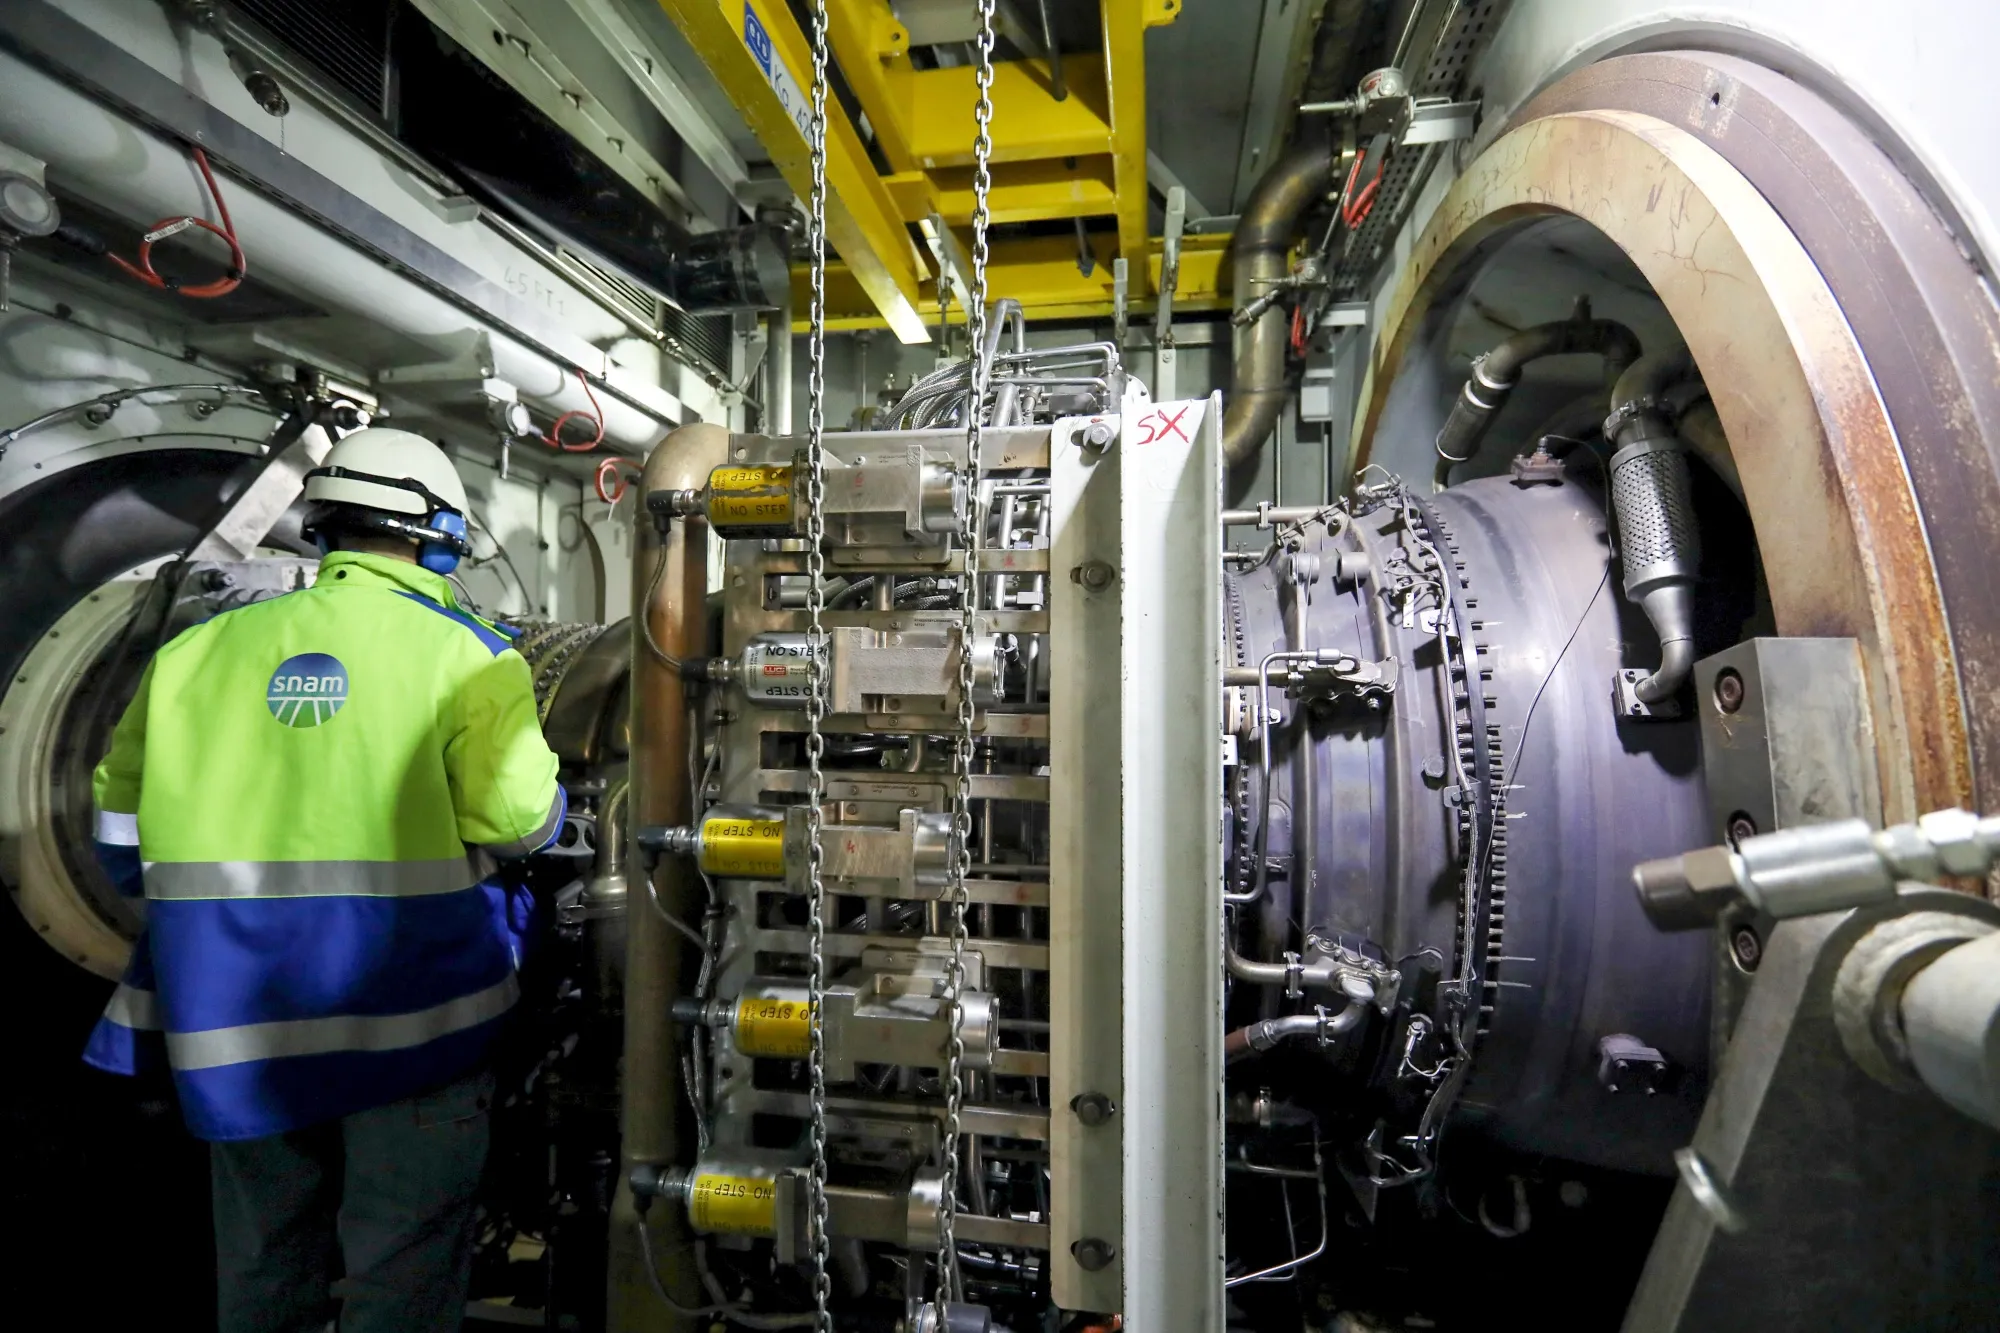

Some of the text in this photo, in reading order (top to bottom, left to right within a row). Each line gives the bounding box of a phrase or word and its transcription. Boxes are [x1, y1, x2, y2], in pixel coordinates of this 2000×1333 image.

[1137, 405, 1190, 446] SX
[730, 471, 762, 482] STEP
[730, 504, 787, 516] NO STEP
[766, 646, 786, 657] NO
[272, 675, 344, 693] snam
[766, 686, 799, 697] STEP
[723, 825, 781, 838] NO STEP
[759, 1006, 792, 1020] STEP
[714, 1183, 772, 1200] NO STEP
